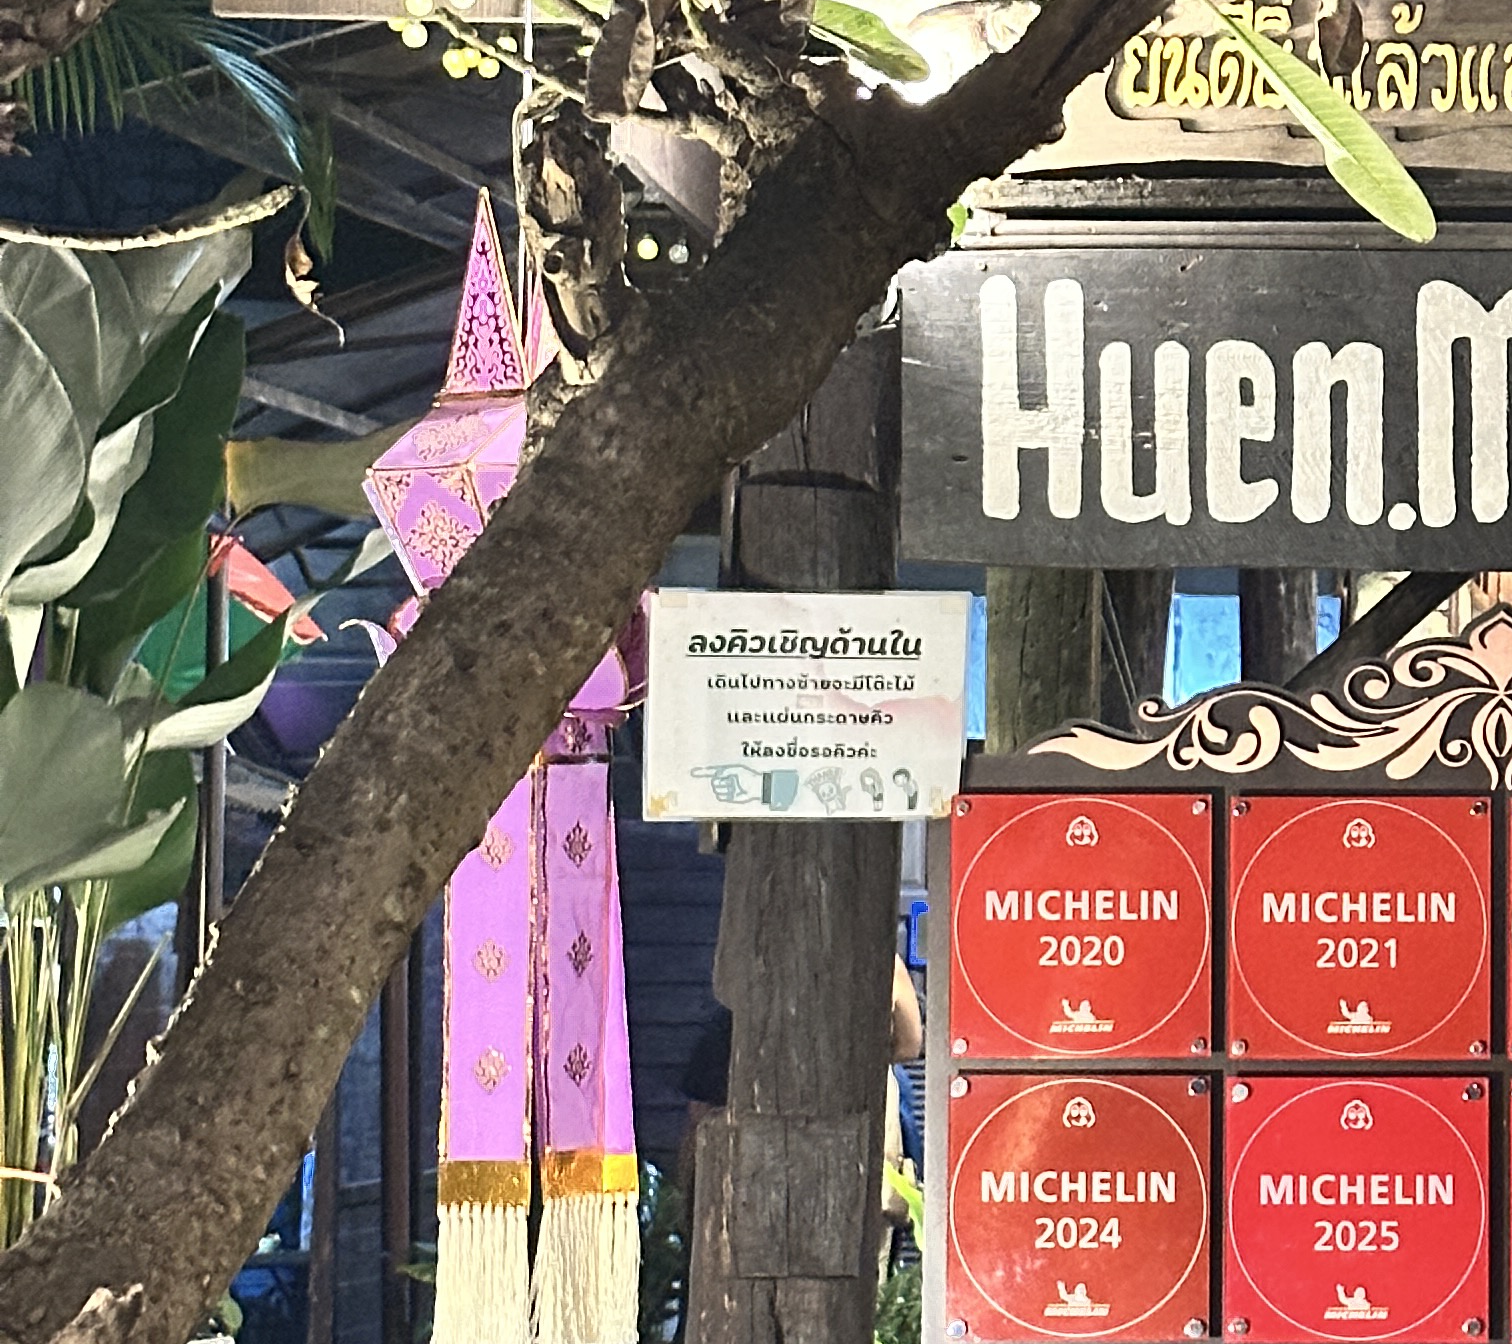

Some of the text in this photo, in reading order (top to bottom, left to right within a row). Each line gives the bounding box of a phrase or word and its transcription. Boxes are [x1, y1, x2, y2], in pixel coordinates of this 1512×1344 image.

[688, 627, 922, 659] ลงคิวเชิญด้านใน
[985, 890, 1178, 922] MICHELIN
[1262, 891, 1456, 923] MICHELIN
[1038, 935, 1125, 967] 2020
[1316, 937, 1398, 968] 2021
[980, 1170, 1176, 1203] MICHELIN
[1258, 1174, 1454, 1205] MICHELIN
[1034, 1217, 1122, 1249] 2024
[1313, 1220, 1400, 1252] 2025
